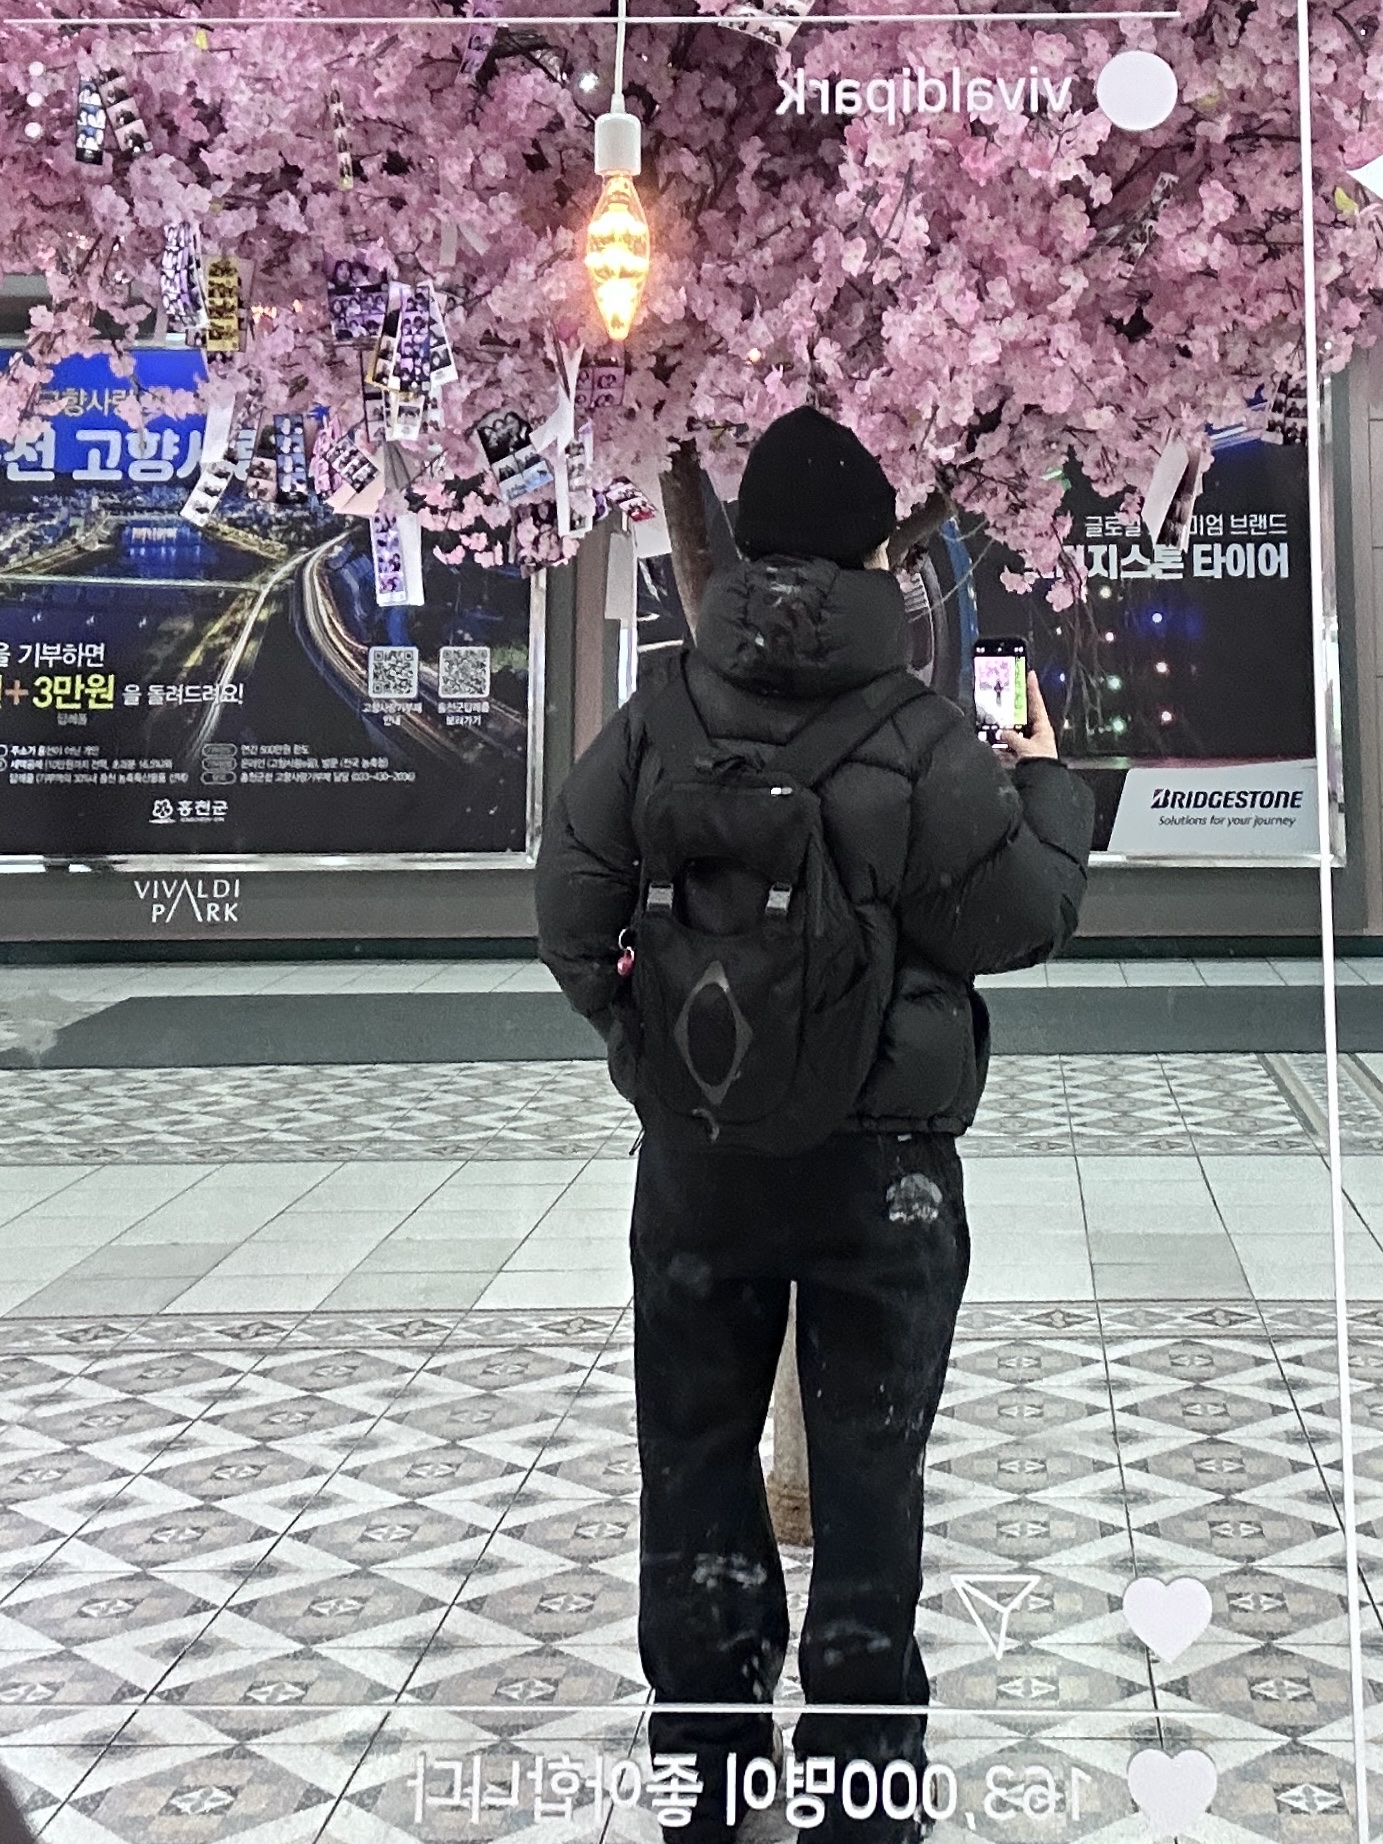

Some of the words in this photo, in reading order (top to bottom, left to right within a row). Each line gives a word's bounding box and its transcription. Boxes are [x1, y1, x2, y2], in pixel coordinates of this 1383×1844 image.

[1230, 513, 1288, 537] 브랜드
[1192, 541, 1290, 580] 타이어
[18, 642, 106, 669] 기부하면
[122, 683, 142, 706] 을
[147, 682, 244, 706] 돌려드려요!
[177, 800, 228, 817] 홍천군
[1150, 788, 1304, 809] BRIDGESTONE
[1158, 815, 1207, 826] Solutions
[1209, 815, 1226, 827] for
[1226, 816, 1251, 828] your
[1252, 816, 1297, 828] journey
[133, 878, 240, 899] VIVALDI
